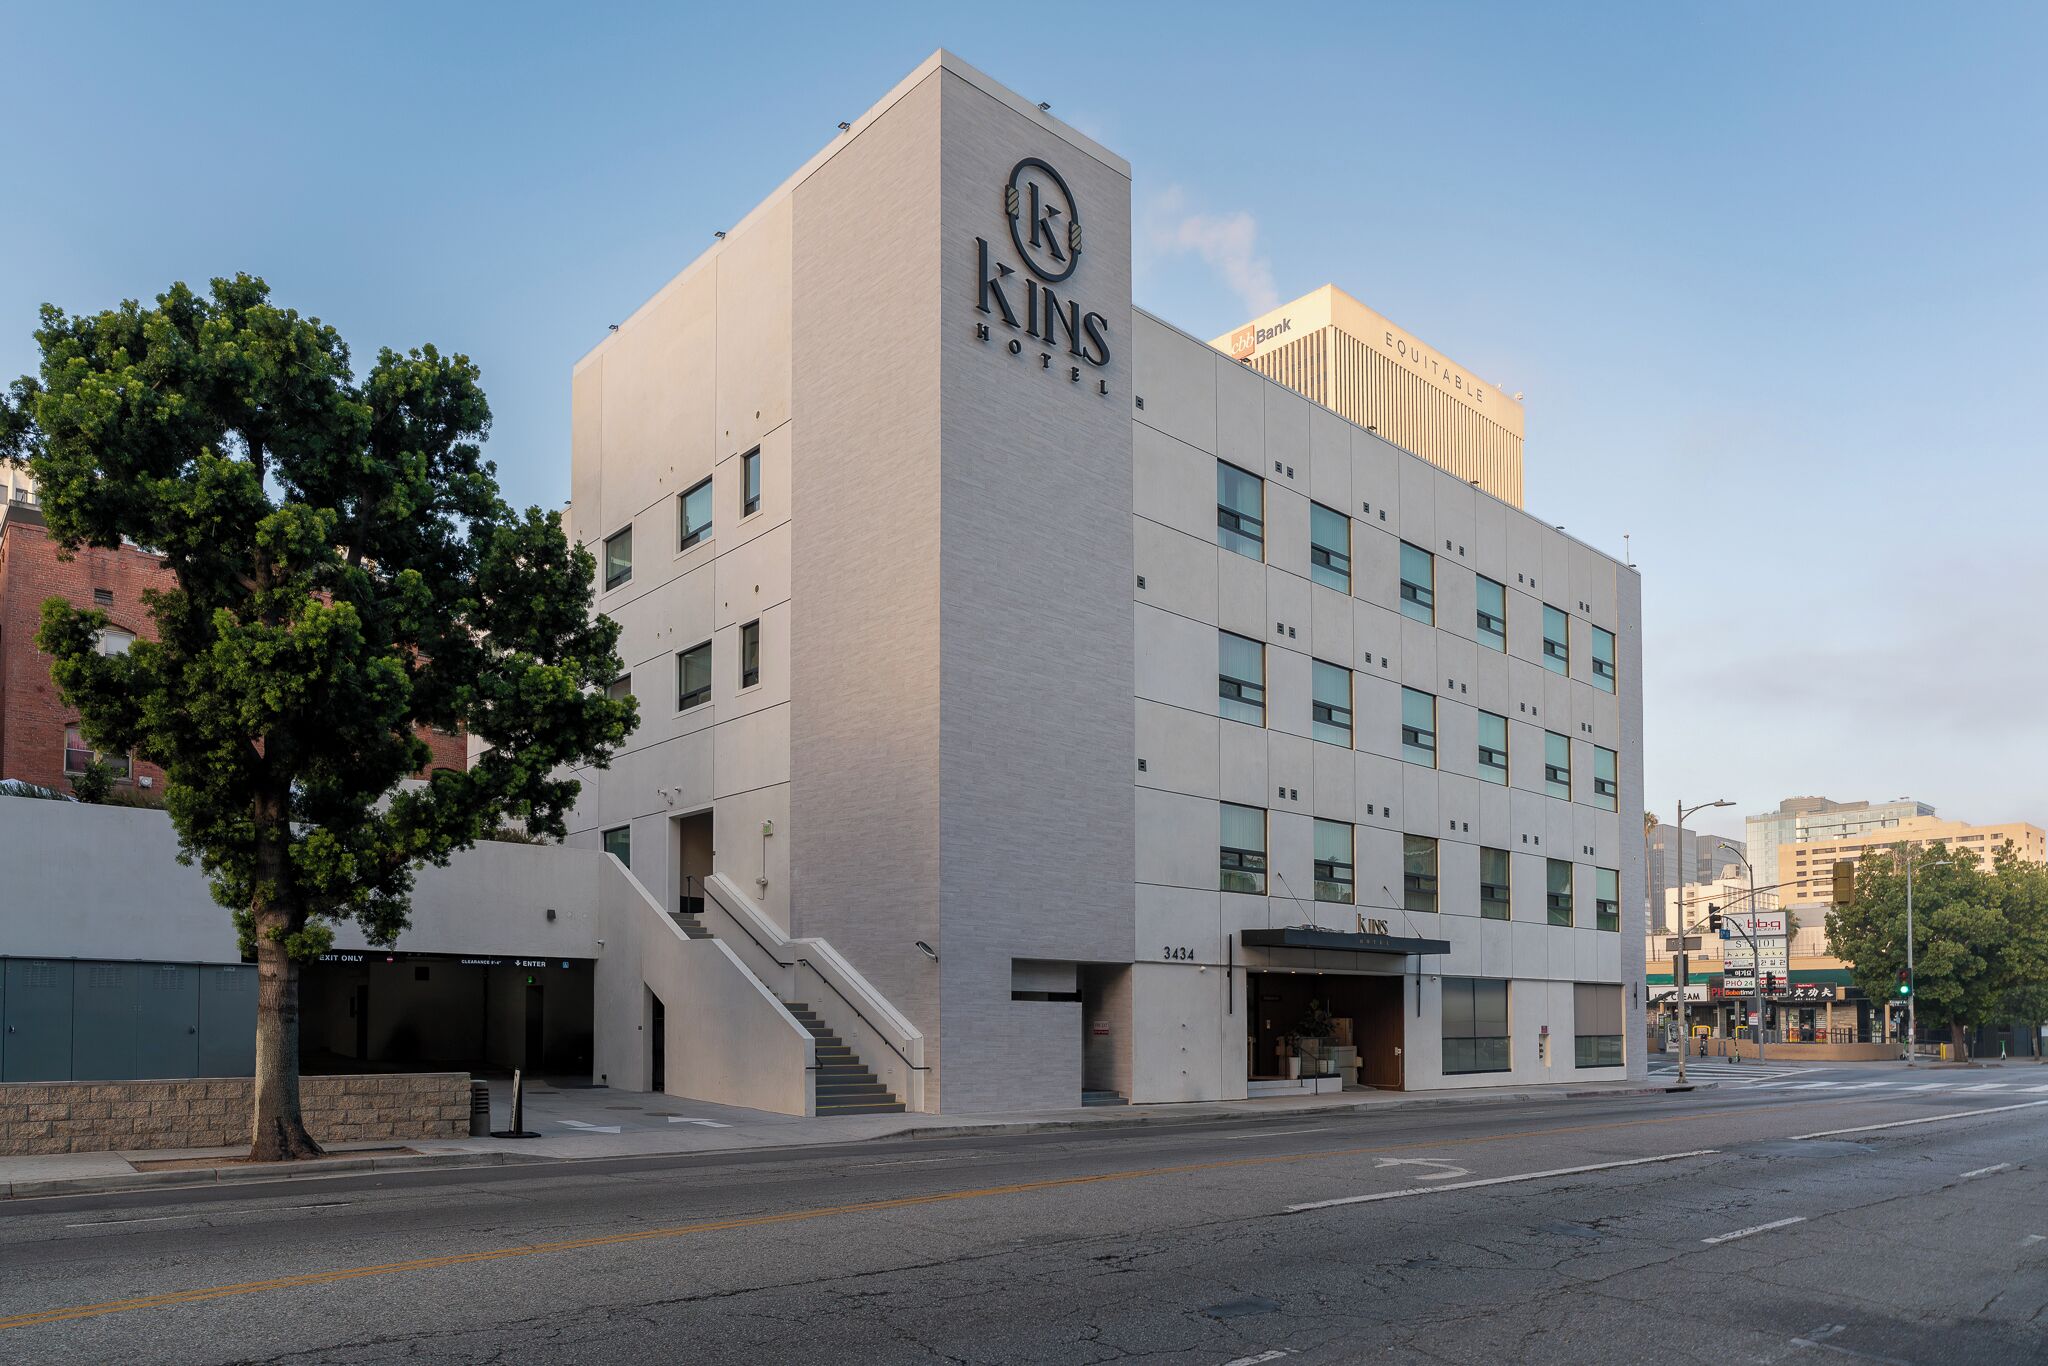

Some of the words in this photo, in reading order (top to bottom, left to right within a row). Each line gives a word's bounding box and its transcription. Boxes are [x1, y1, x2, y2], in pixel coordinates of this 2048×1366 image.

[976, 236, 1110, 366] KINS
[1256, 318, 1291, 344] Bank
[976, 323, 1108, 395] HOTEL
[1386, 332, 1483, 403] EQUITABLE
[1357, 913, 1389, 936] KINS
[341, 954, 364, 962] ONLY
[522, 960, 546, 968] ENTER
[1164, 946, 1194, 961] 3434
[1671, 993, 1700, 1001] CEAM
